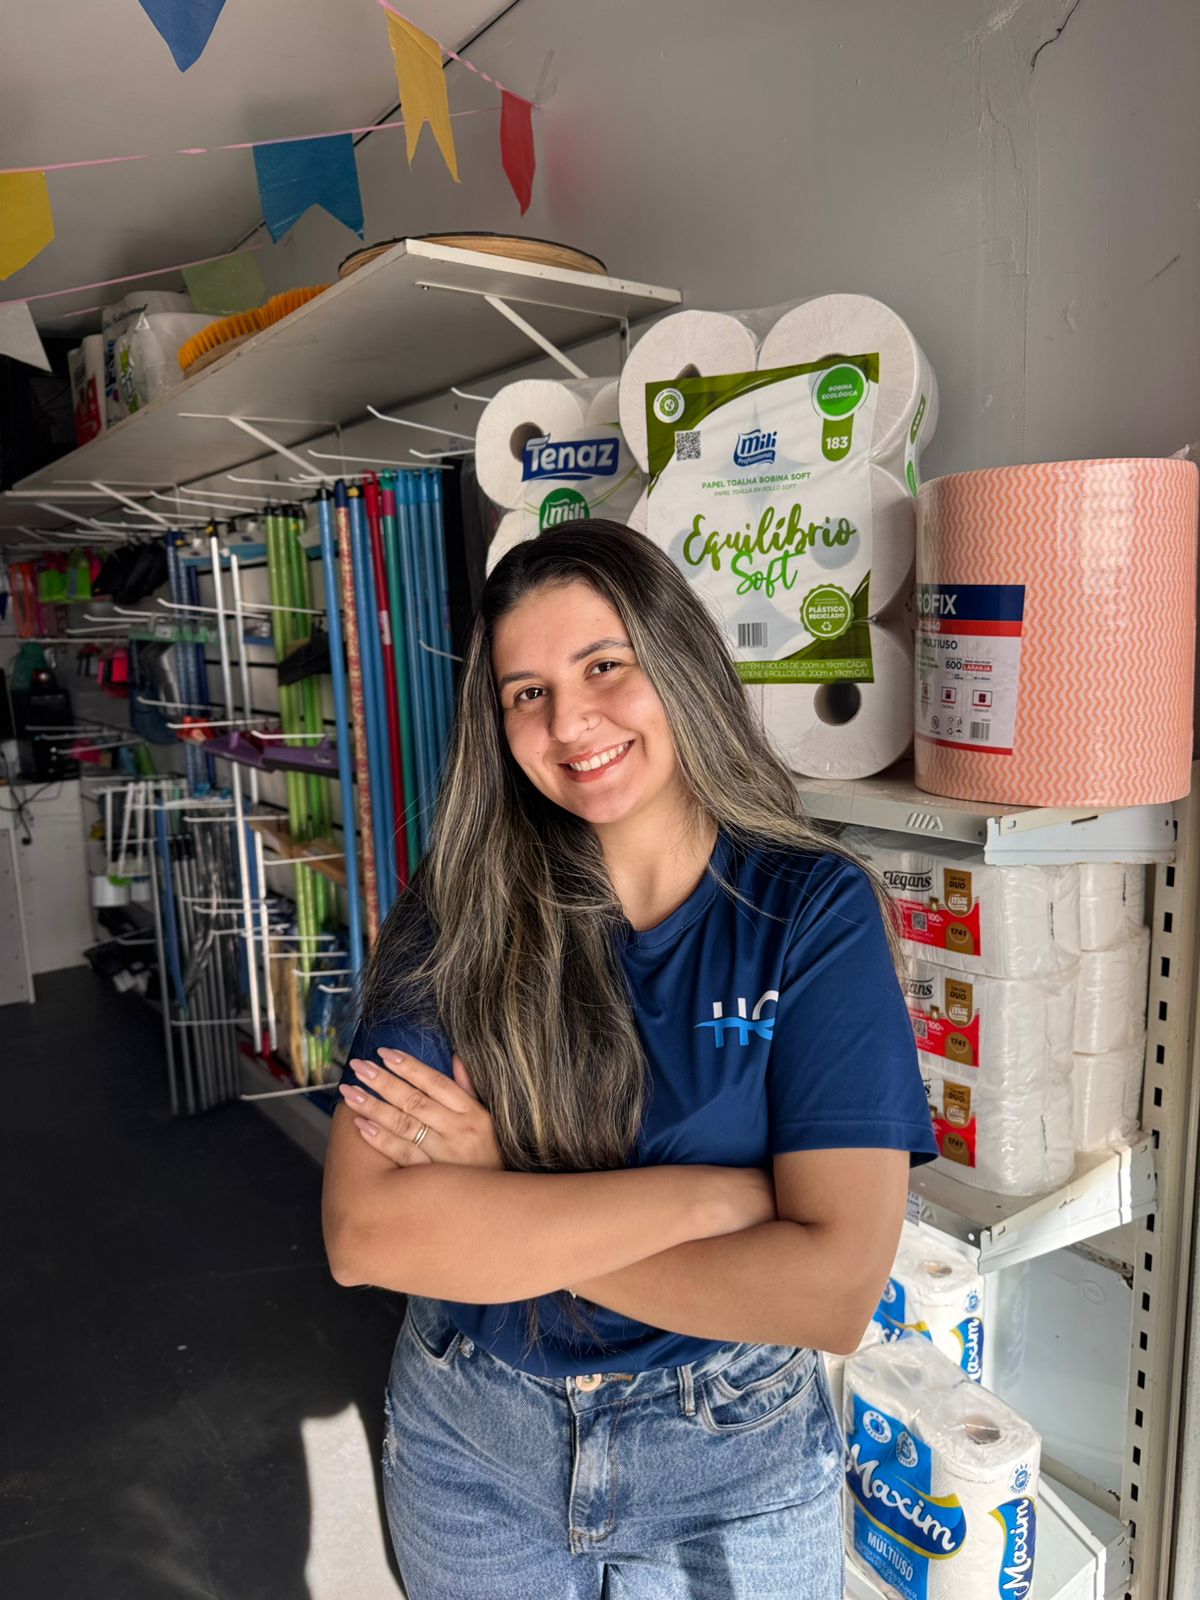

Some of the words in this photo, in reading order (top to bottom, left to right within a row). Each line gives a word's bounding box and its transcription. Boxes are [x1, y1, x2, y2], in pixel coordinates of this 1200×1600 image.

[828, 384, 853, 392] BOBINA
[822, 390, 858, 400] ECOLÓGICA
[826, 436, 849, 449] 183
[526, 435, 614, 472] Tenaz
[738, 453, 773, 464] Professional
[702, 481, 725, 489] PAPEL
[727, 478, 757, 487] TOALHA
[759, 475, 789, 484] BOBINA
[791, 472, 811, 480] SOFT
[683, 503, 857, 571] Equilíbrio
[731, 550, 806, 598] Soft
[809, 605, 845, 614] PLÁSTICO
[809, 612, 845, 620] RECICLADO
[923, 637, 958, 650] MULTIUSO
[766, 662, 788, 670] ROLOS
[846, 660, 867, 668] CADA
[945, 660, 962, 670] 600
[949, 881, 966, 889] DUO
[951, 928, 967, 937] 1741
[950, 991, 966, 1000] DUO
[950, 1037, 966, 1047] 1741
[948, 1092, 965, 1102] DUO
[845, 1443, 956, 1551] Maxim
[1002, 1499, 1031, 1596] Maxim
[867, 1531, 914, 1581] MULTIUSO
